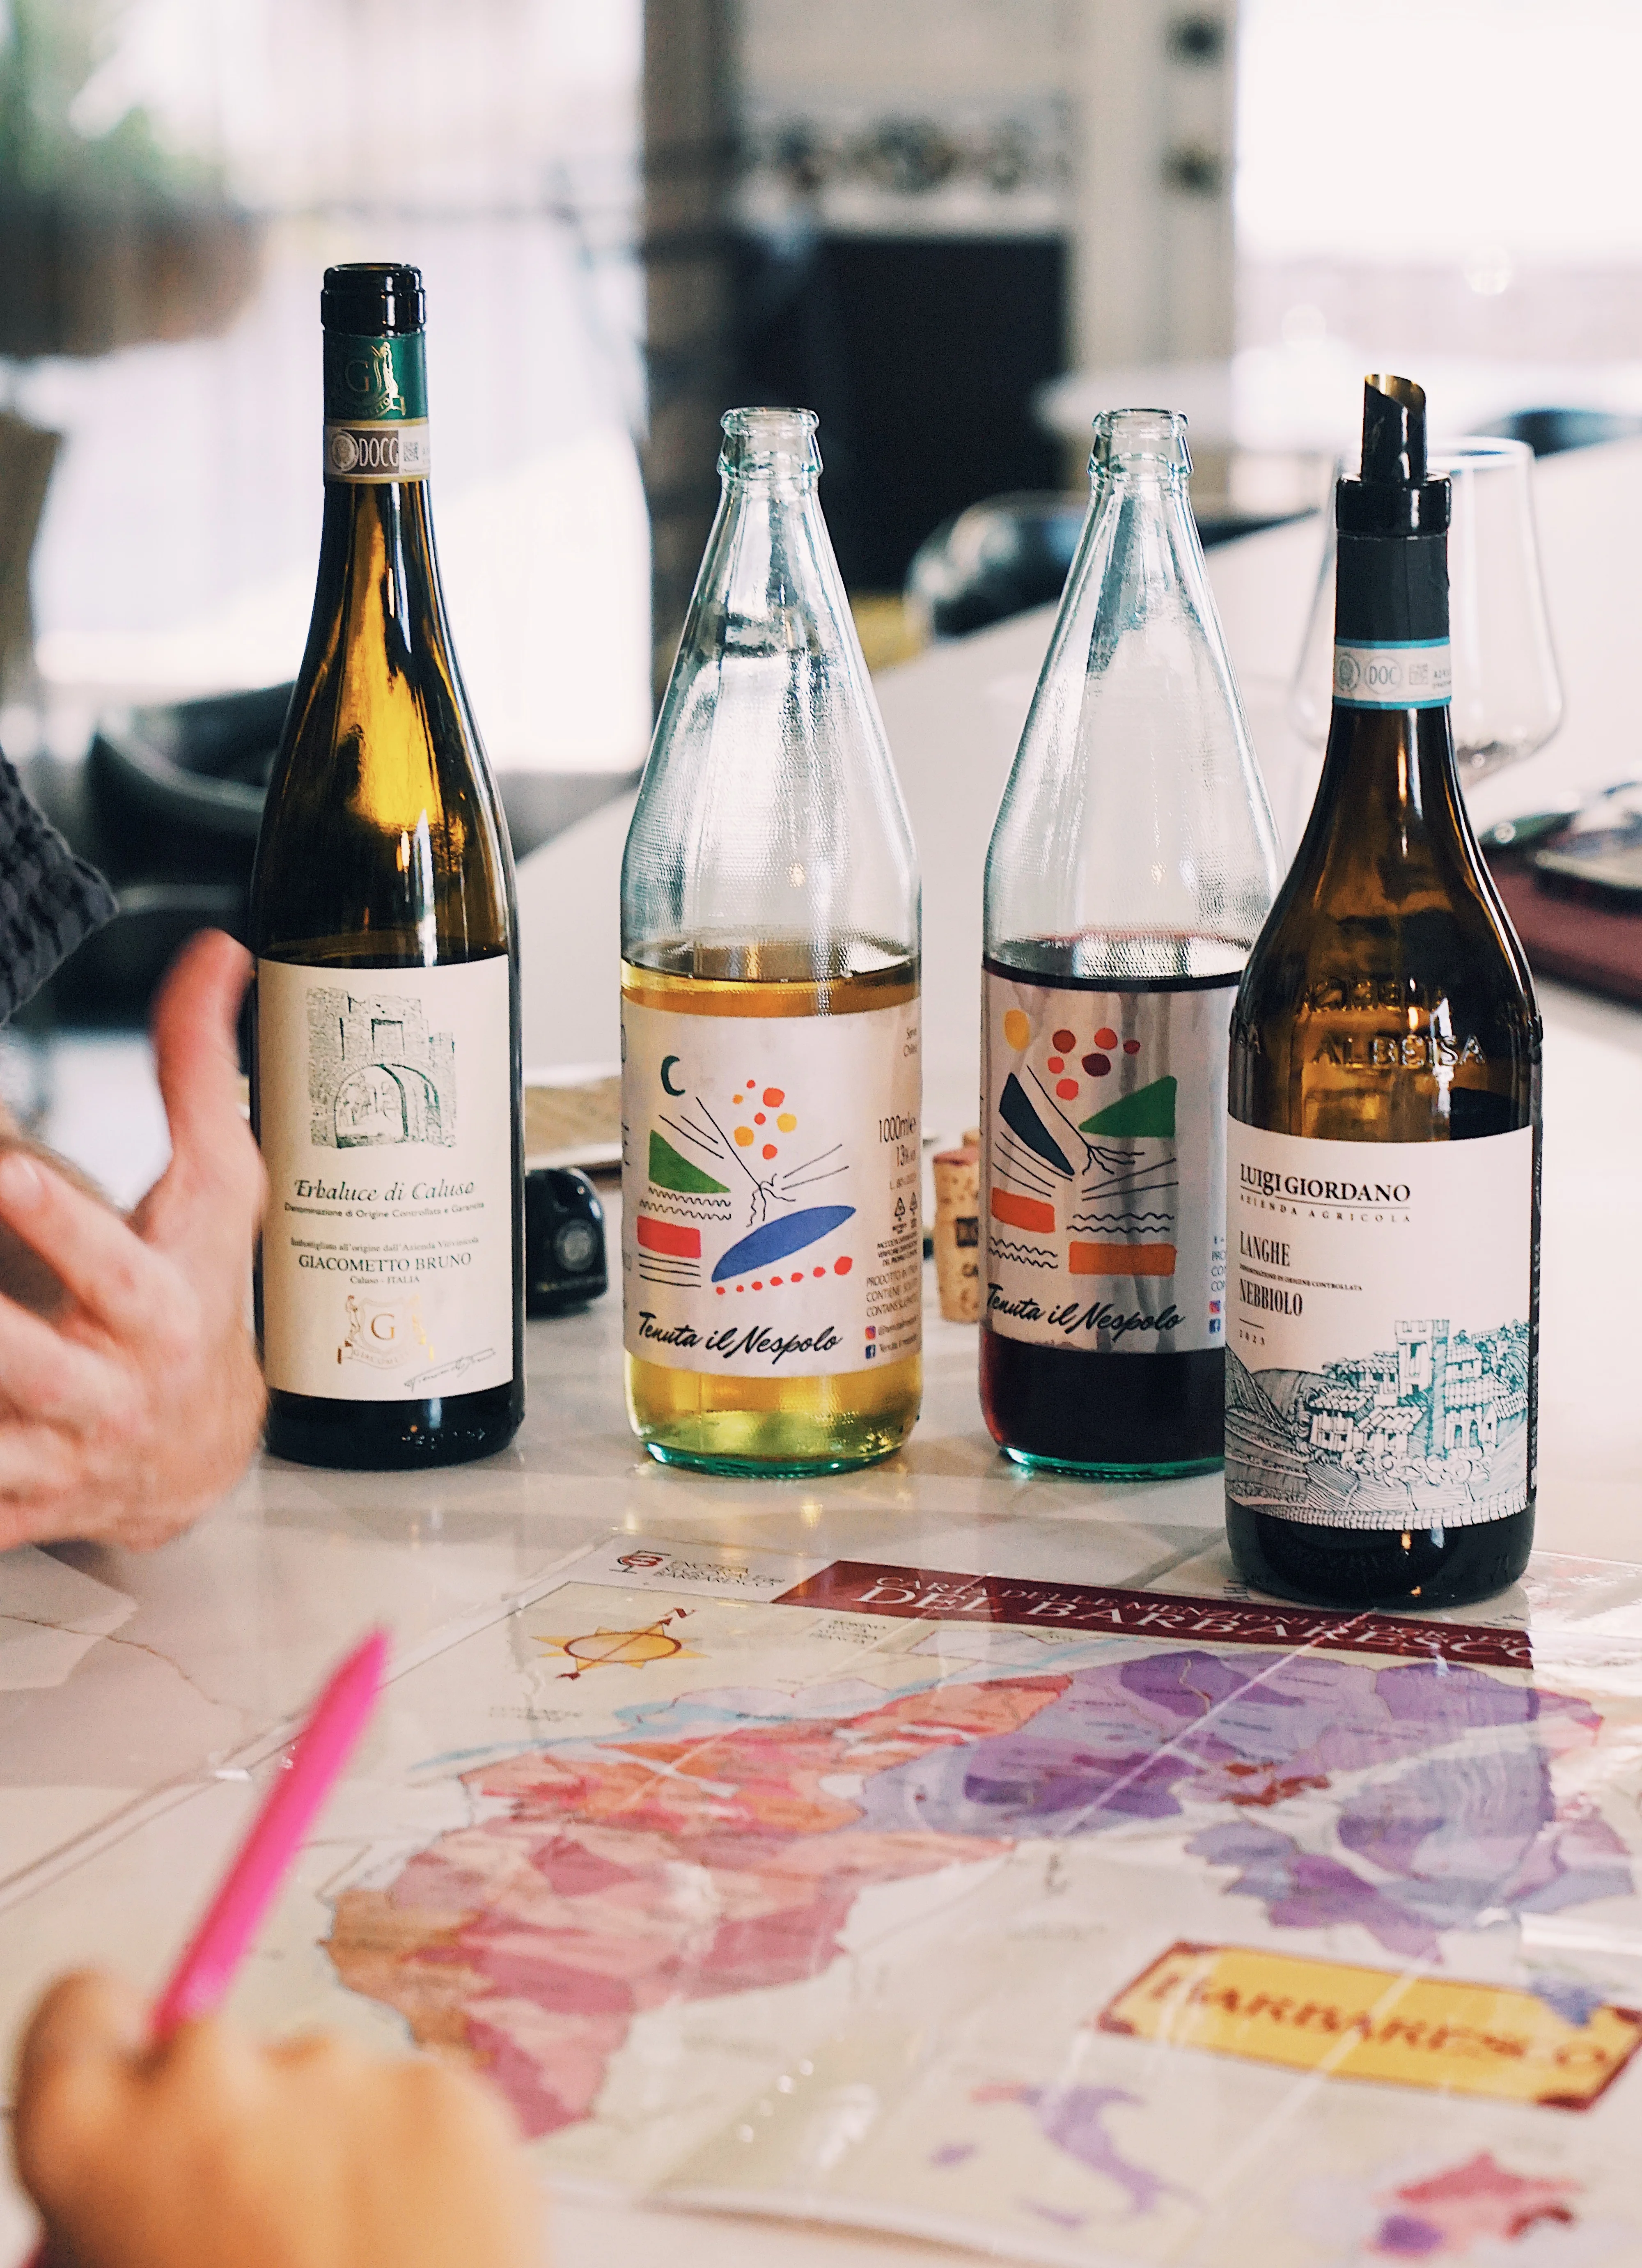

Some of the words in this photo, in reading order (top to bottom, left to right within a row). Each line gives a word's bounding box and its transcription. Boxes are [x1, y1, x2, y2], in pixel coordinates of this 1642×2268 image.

[359, 438, 399, 468] DOCG
[1369, 666, 1398, 685] DOC
[1314, 1033, 1486, 1067] ALBEISA
[294, 1179, 380, 1201] Erbaluce
[385, 1181, 404, 1201] di
[412, 1179, 475, 1200] Caluso
[1284, 1176, 1411, 1202] GIORDANO
[356, 1210, 388, 1220] Origine
[392, 1208, 441, 1218] Controllata
[1240, 1194, 1297, 1215] AZIENDA
[1309, 1210, 1410, 1222] AGRICOLA
[299, 1253, 410, 1272] GIACOMETTO
[415, 1252, 471, 1270] BRUNO
[1240, 1230, 1291, 1267] LANGHE
[350, 1275, 379, 1285] Caluso
[387, 1275, 420, 1284] ITALIA
[1240, 1278, 1303, 1316] NEBBIOLO
[371, 1312, 394, 1341] G
[988, 1283, 1046, 1321] Tenuta
[1048, 1302, 1079, 1325] il
[1066, 1301, 1185, 1342] Nespolo
[639, 1311, 699, 1348] Tenuta
[705, 1327, 738, 1351] il
[724, 1325, 842, 1364] Nespolo
[852, 1585, 1004, 1612] DEL
[876, 1576, 987, 1596] CARTA
[1125, 1601, 1310, 1625] MENZIONI
